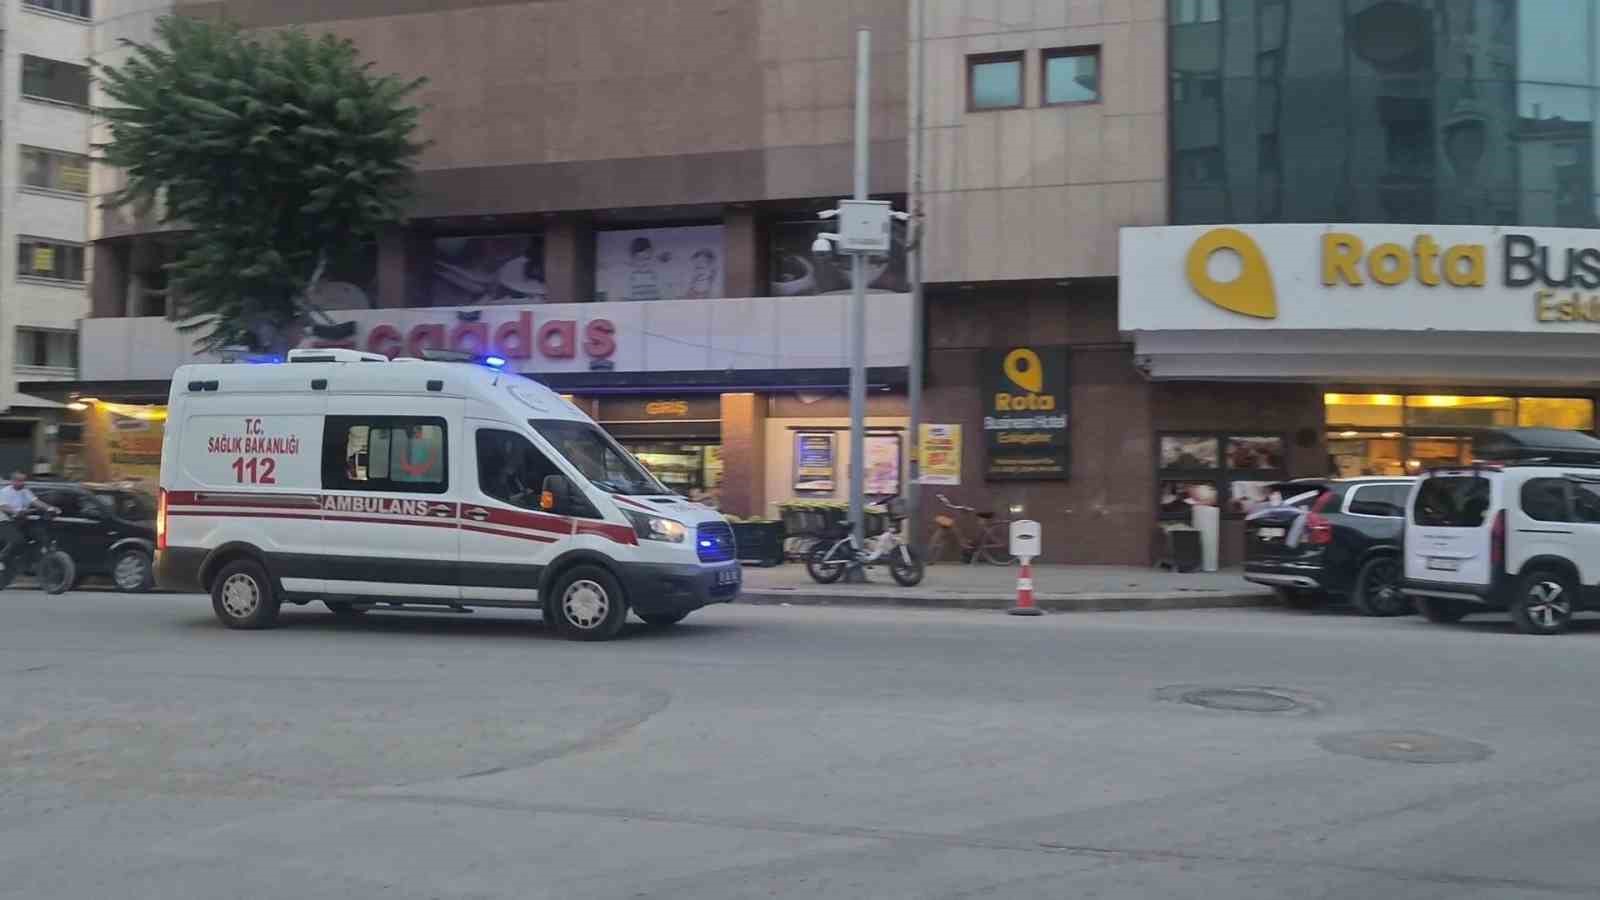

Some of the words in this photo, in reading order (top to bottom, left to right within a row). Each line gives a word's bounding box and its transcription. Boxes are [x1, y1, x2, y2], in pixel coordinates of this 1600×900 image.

[1320, 233, 1488, 287] Rota
[994, 391, 1056, 412] Rota
[245, 418, 264, 434] T.C.
[207, 433, 241, 453] SAĞLIK
[245, 433, 300, 455] BAKANLIĞI
[232, 456, 276, 484] 112
[323, 494, 429, 516] AMBULANS
